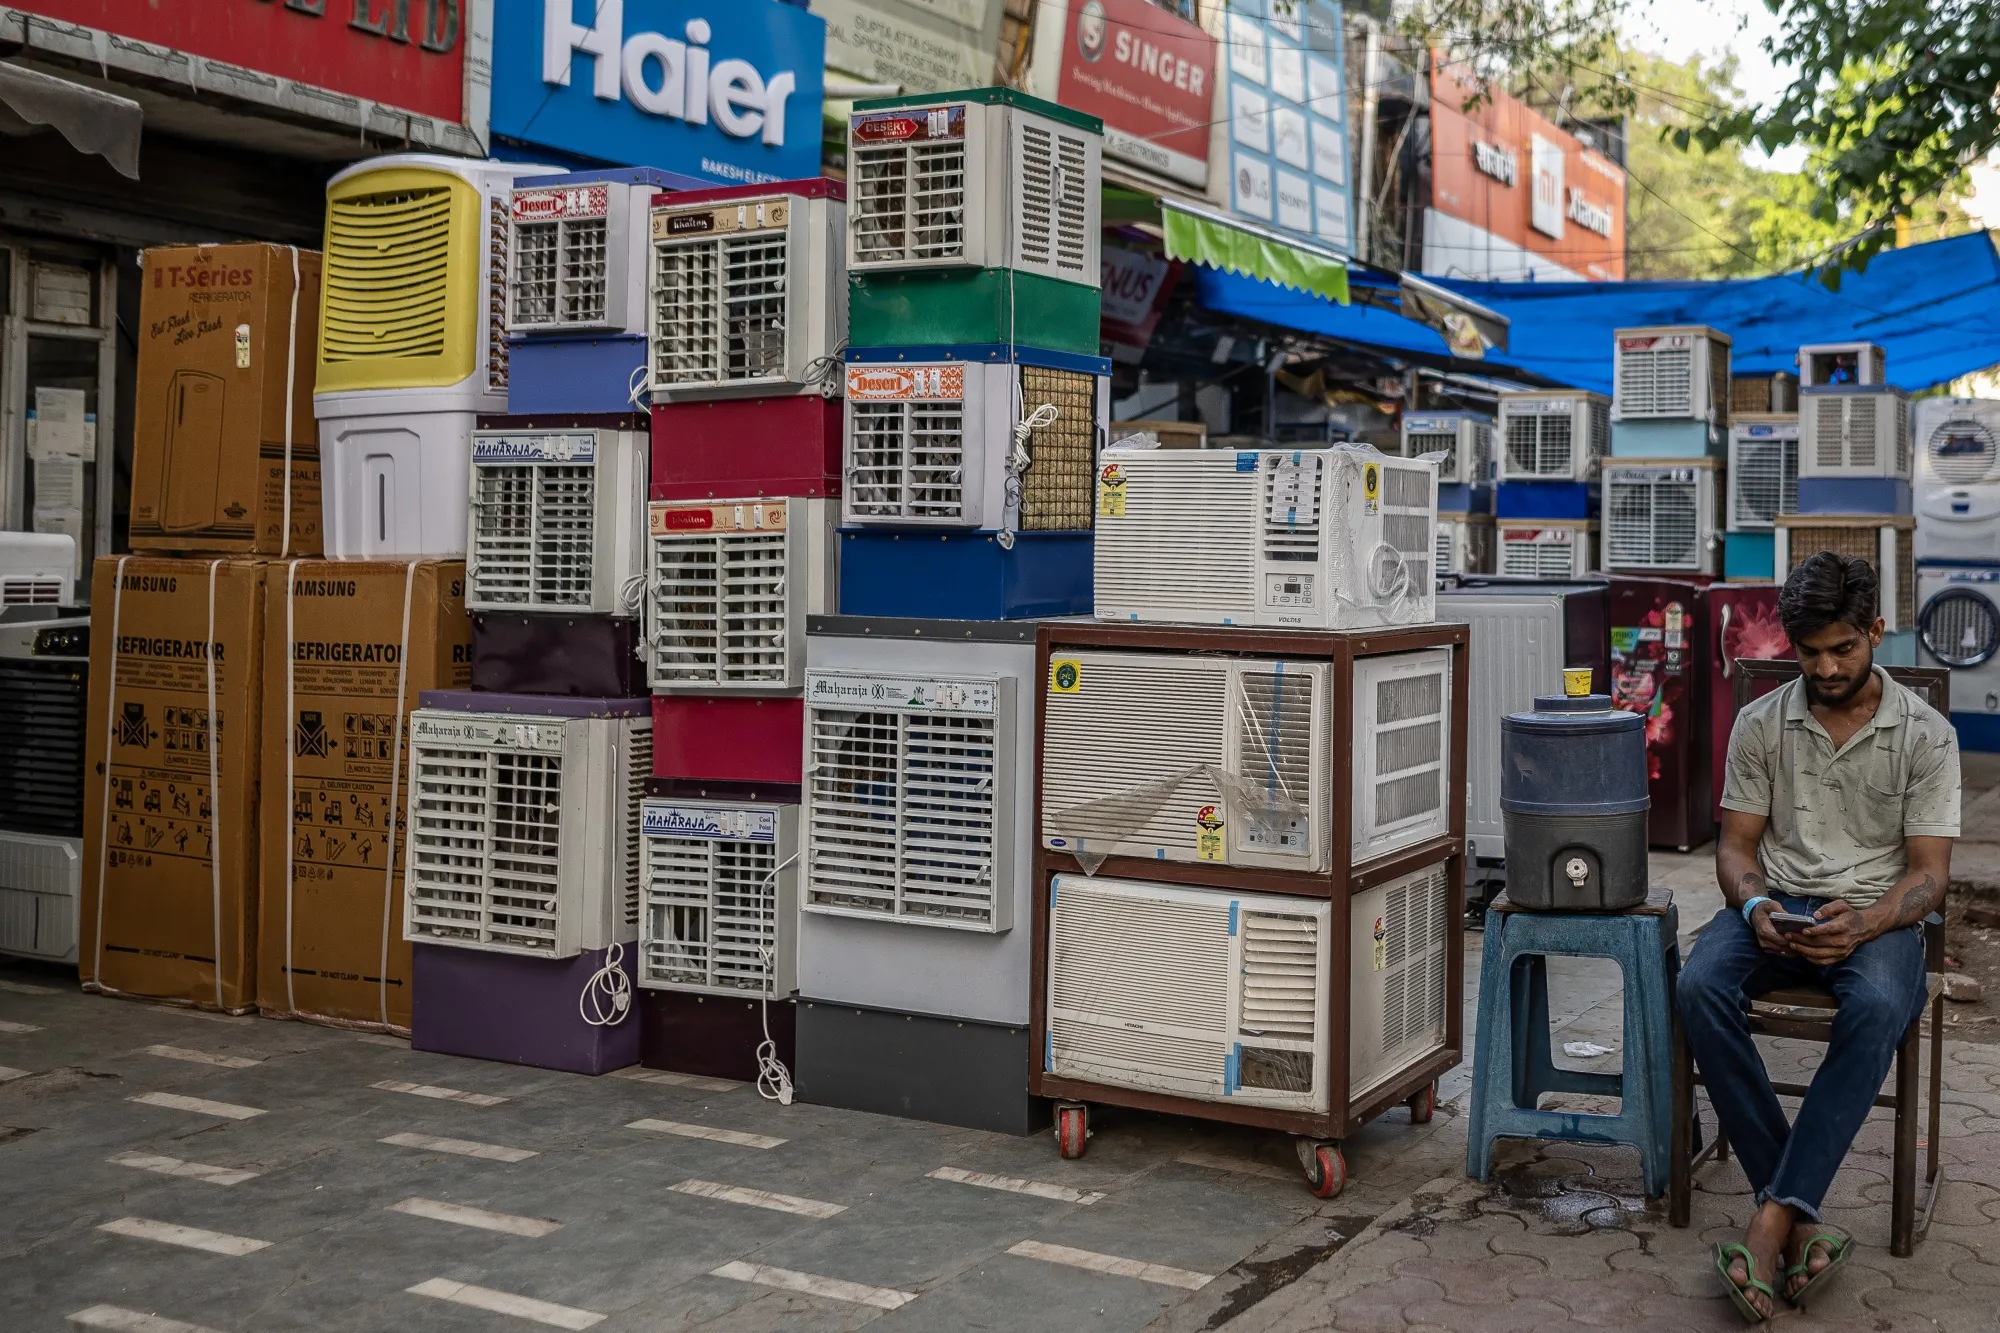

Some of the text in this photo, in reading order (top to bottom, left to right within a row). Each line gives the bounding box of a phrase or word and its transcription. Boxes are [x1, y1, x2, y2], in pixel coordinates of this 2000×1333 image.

[1114, 29, 1204, 96] SINGER
[542, 0, 796, 146] Haier
[865, 121, 907, 133] DESERT
[701, 156, 743, 180] RAKESH
[519, 199, 557, 212] Desert
[1568, 188, 1612, 238] Xiaomi
[168, 265, 252, 288] T-Series
[189, 291, 252, 303] REFRIGERATOR
[857, 377, 901, 391] Desert
[476, 444, 530, 456] MAHARAJA
[287, 579, 356, 597] AMSUNG
[813, 681, 868, 698] Maharaja
[416, 722, 461, 738] Maharaja
[353, 765, 371, 773] NOTICE
[327, 781, 352, 789] DELIVERY
[645, 815, 705, 829] MAHARAJA
